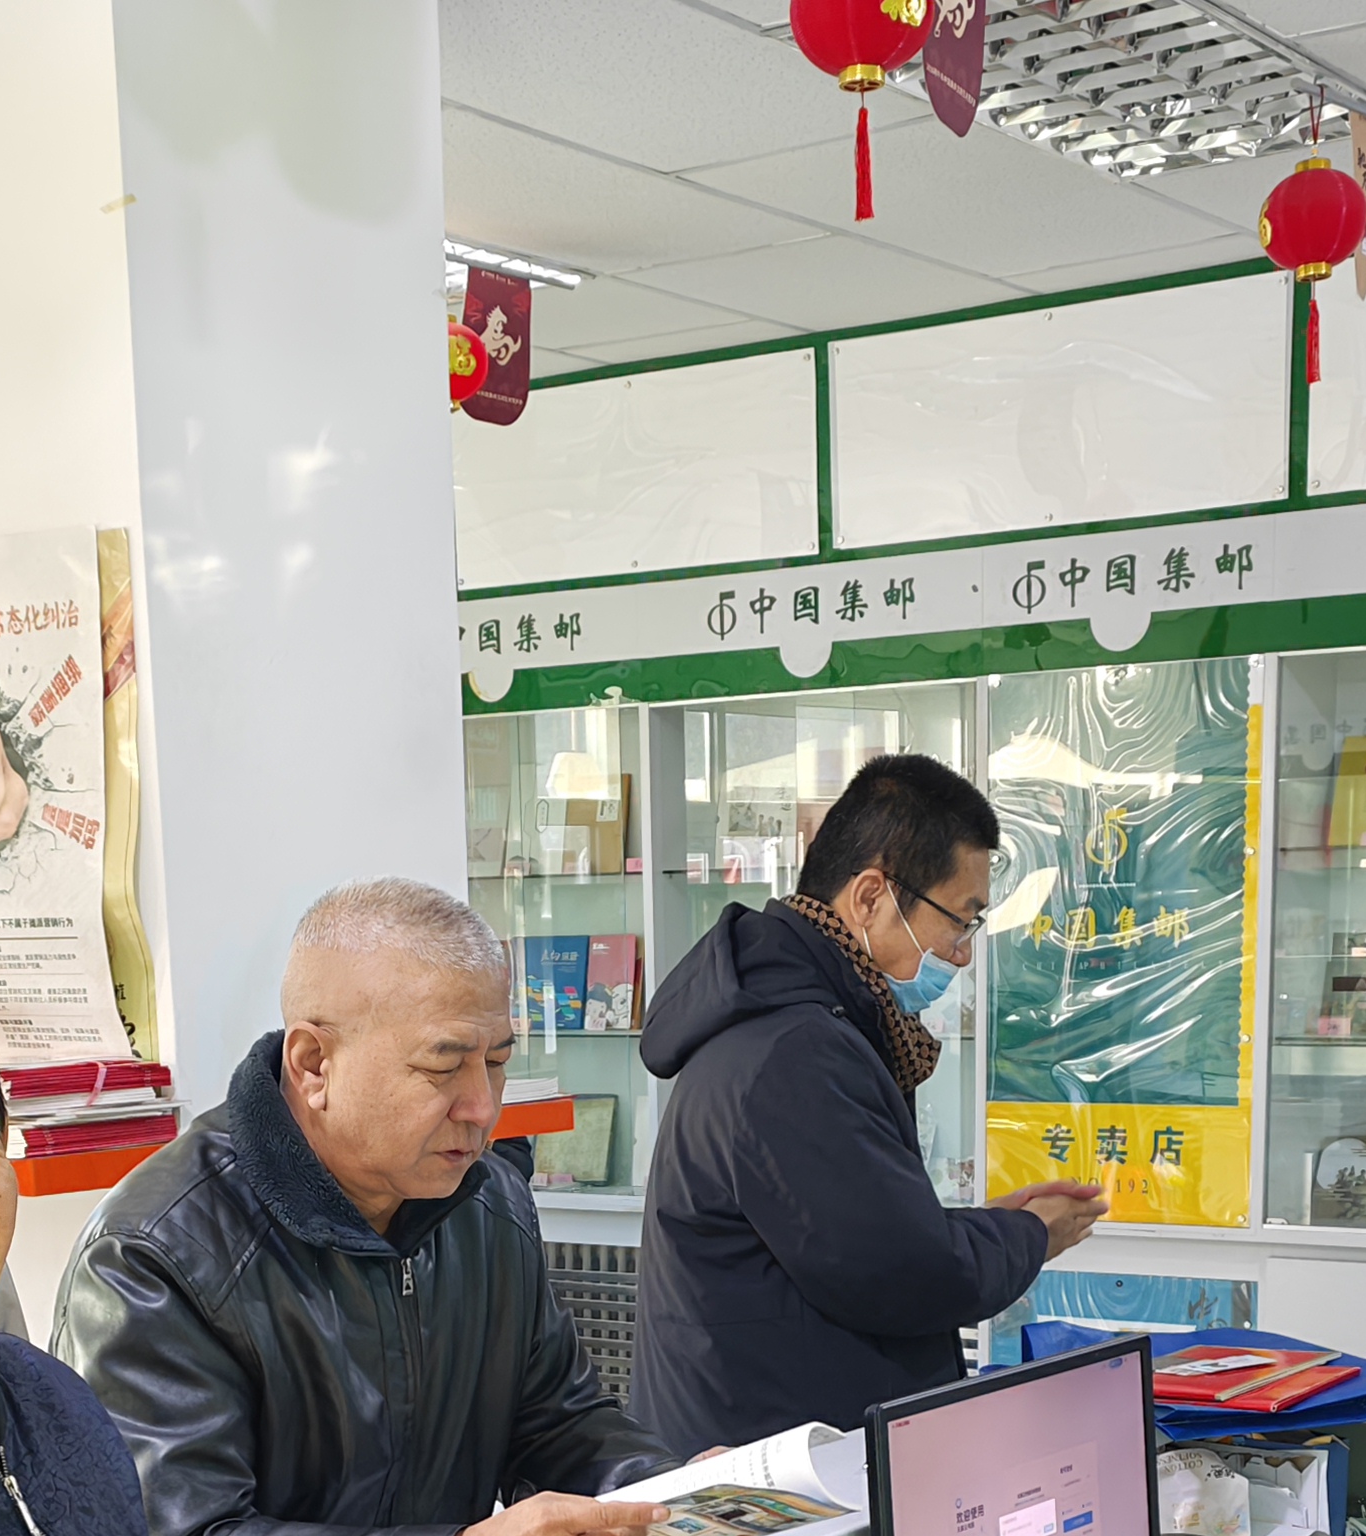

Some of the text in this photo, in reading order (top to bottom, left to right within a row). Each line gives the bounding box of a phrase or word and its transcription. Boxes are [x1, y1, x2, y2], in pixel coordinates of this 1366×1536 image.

[1058, 543, 1254, 608] 中国集邮
[749, 577, 916, 634] 中国集邮
[458, 611, 582, 655] 国集邮
[1026, 904, 1190, 951] 中国集邮
[1041, 1123, 1185, 1167] 专卖店
[1115, 1178, 1149, 1195] 192
